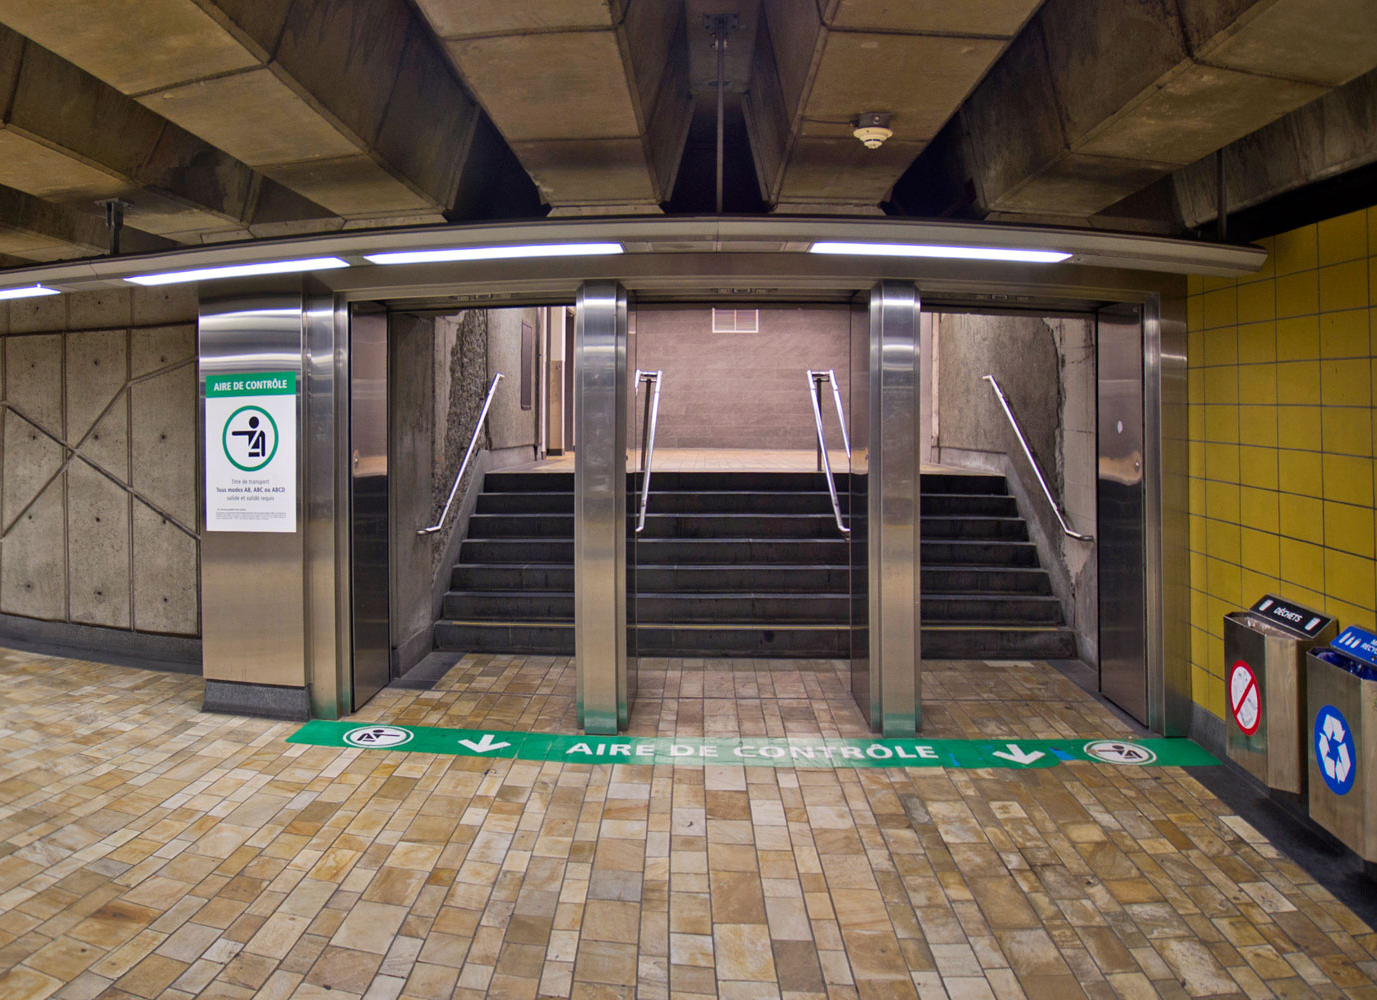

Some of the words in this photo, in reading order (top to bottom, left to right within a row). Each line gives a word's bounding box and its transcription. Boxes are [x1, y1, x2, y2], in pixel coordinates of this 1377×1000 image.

[214, 382, 231, 391] AIRE
[233, 381, 244, 390] DE
[245, 378, 288, 390] CONTRÔLE
[1274, 607, 1302, 622] DÉCHETS
[566, 742, 655, 757] AIRE
[670, 744, 719, 758] DE
[733, 743, 939, 759] CONTRÔLE
